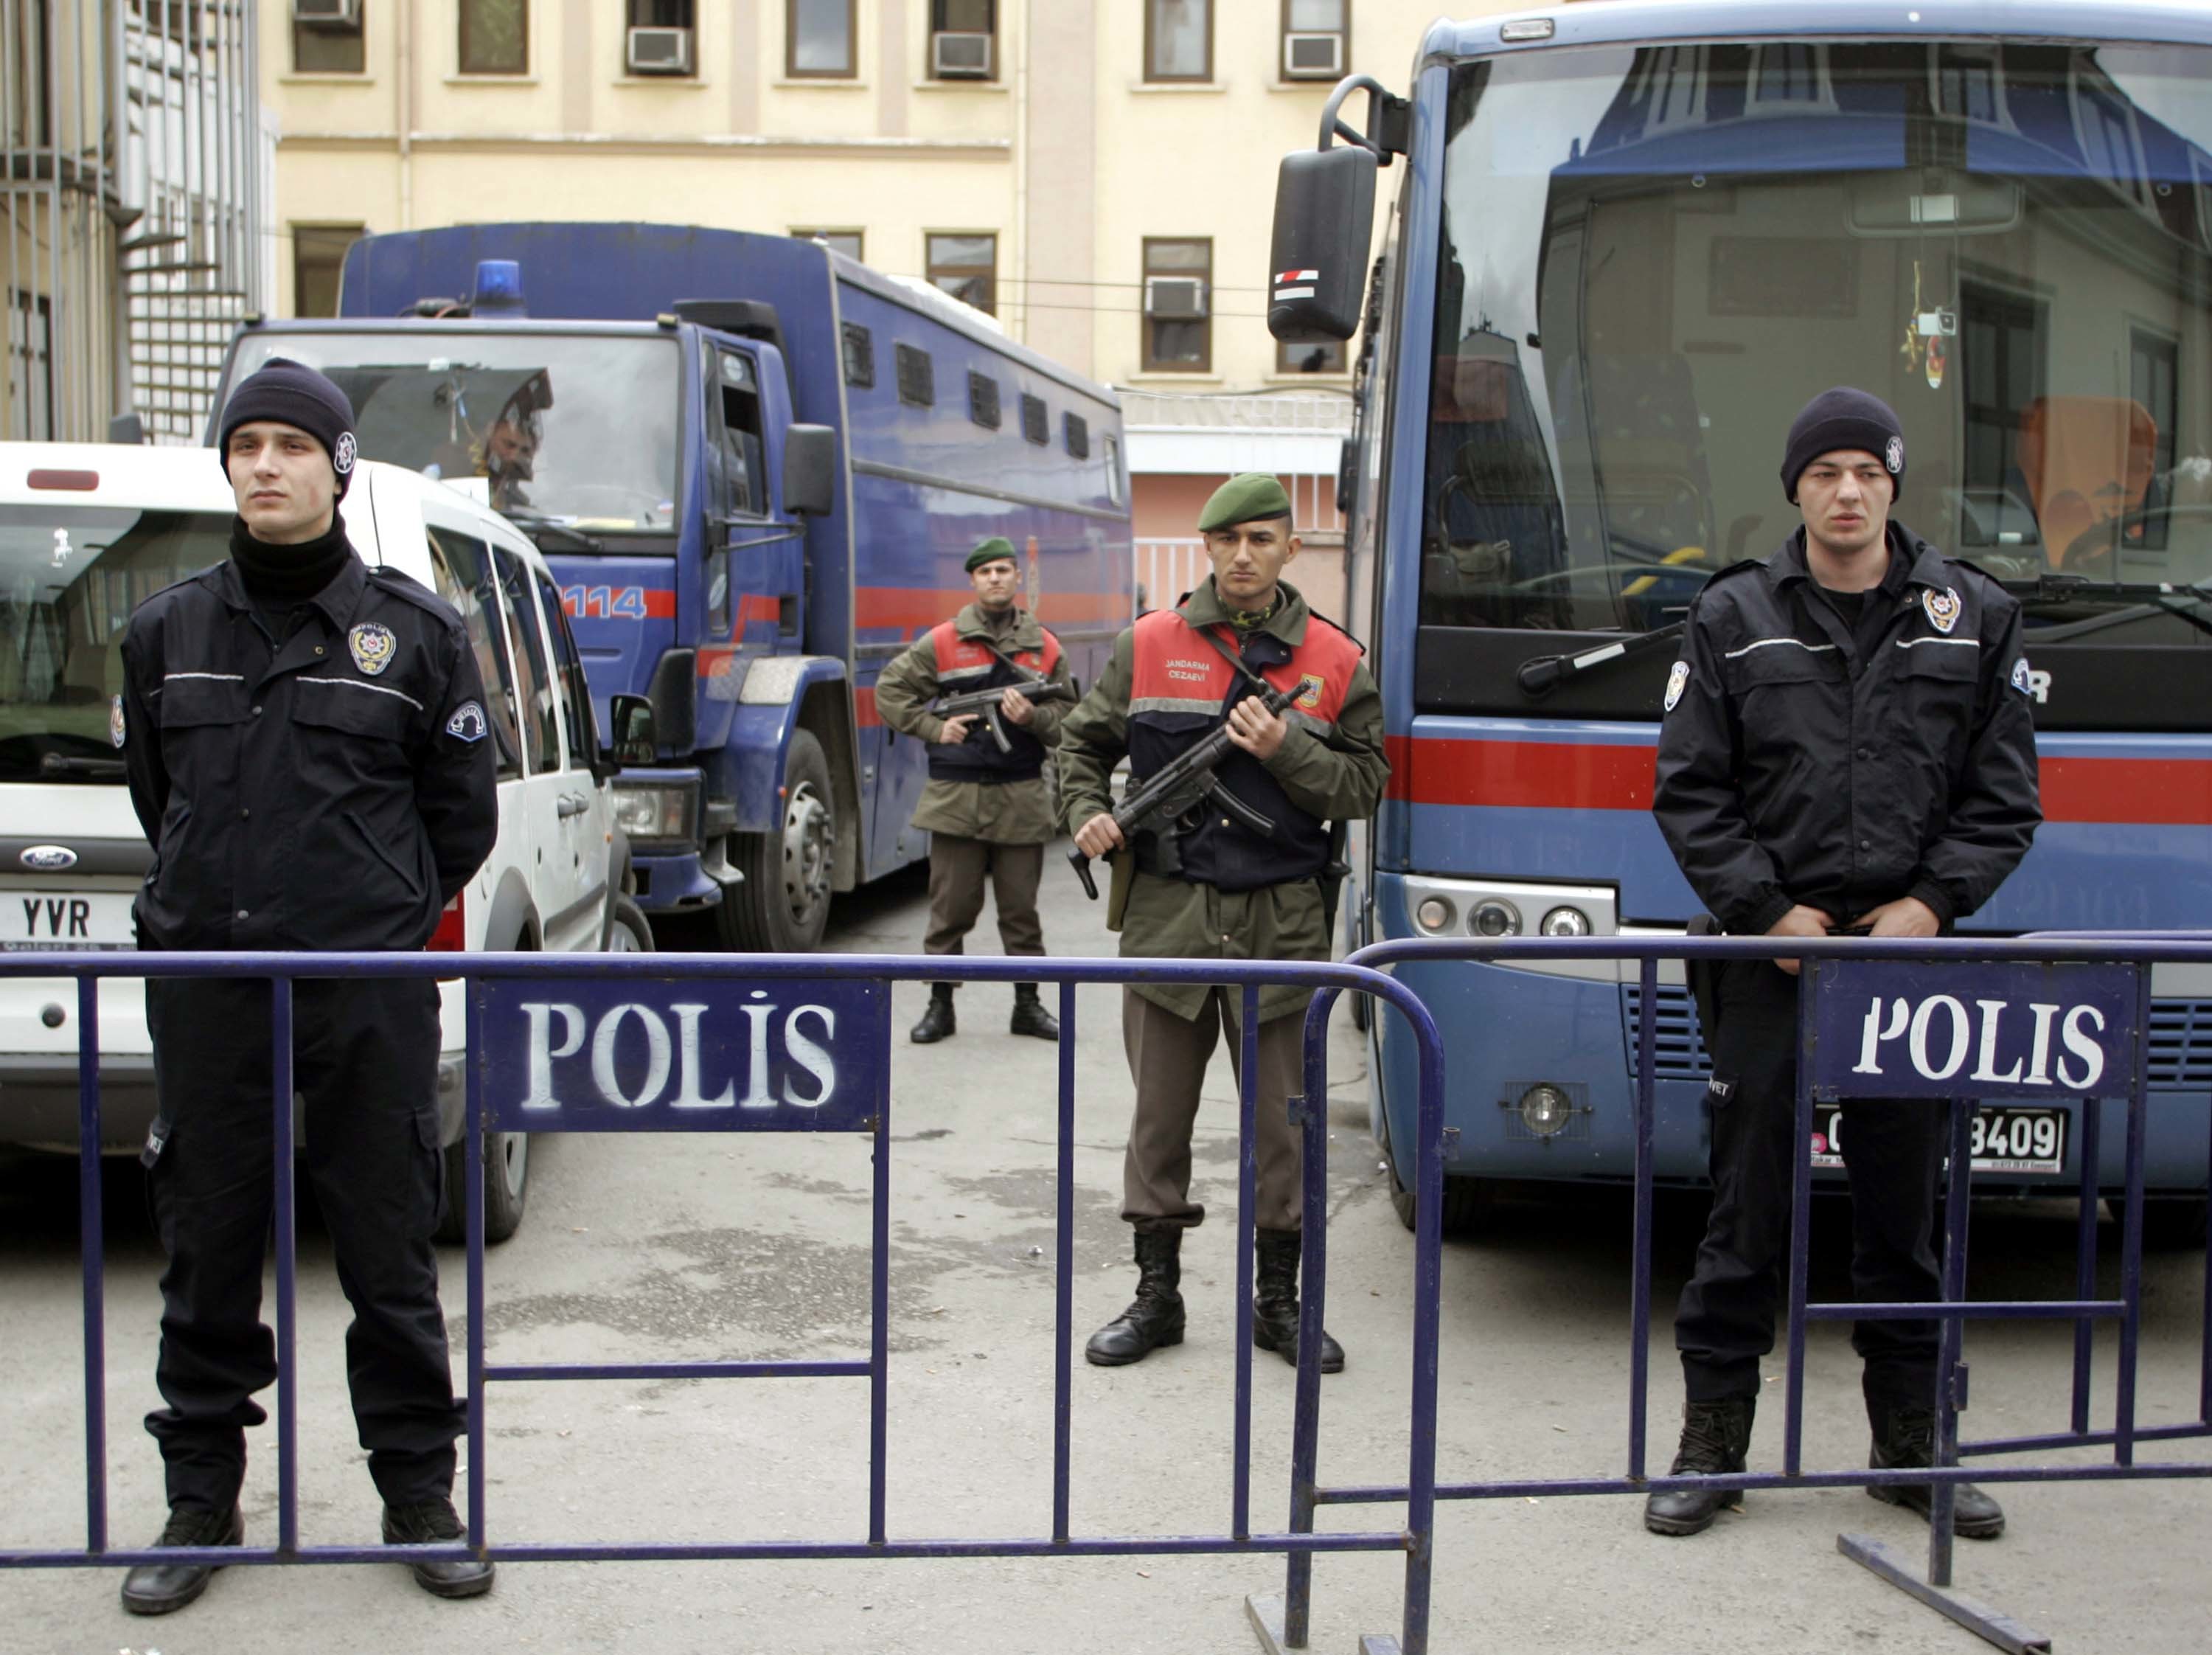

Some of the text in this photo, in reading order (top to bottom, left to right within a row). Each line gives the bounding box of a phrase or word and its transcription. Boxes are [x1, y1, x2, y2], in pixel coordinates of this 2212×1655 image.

[1166, 659, 1211, 671] JANDARMA
[23, 898, 91, 937] YVR
[519, 990, 835, 1109] POLİS
[1852, 994, 2105, 1090] POLIS
